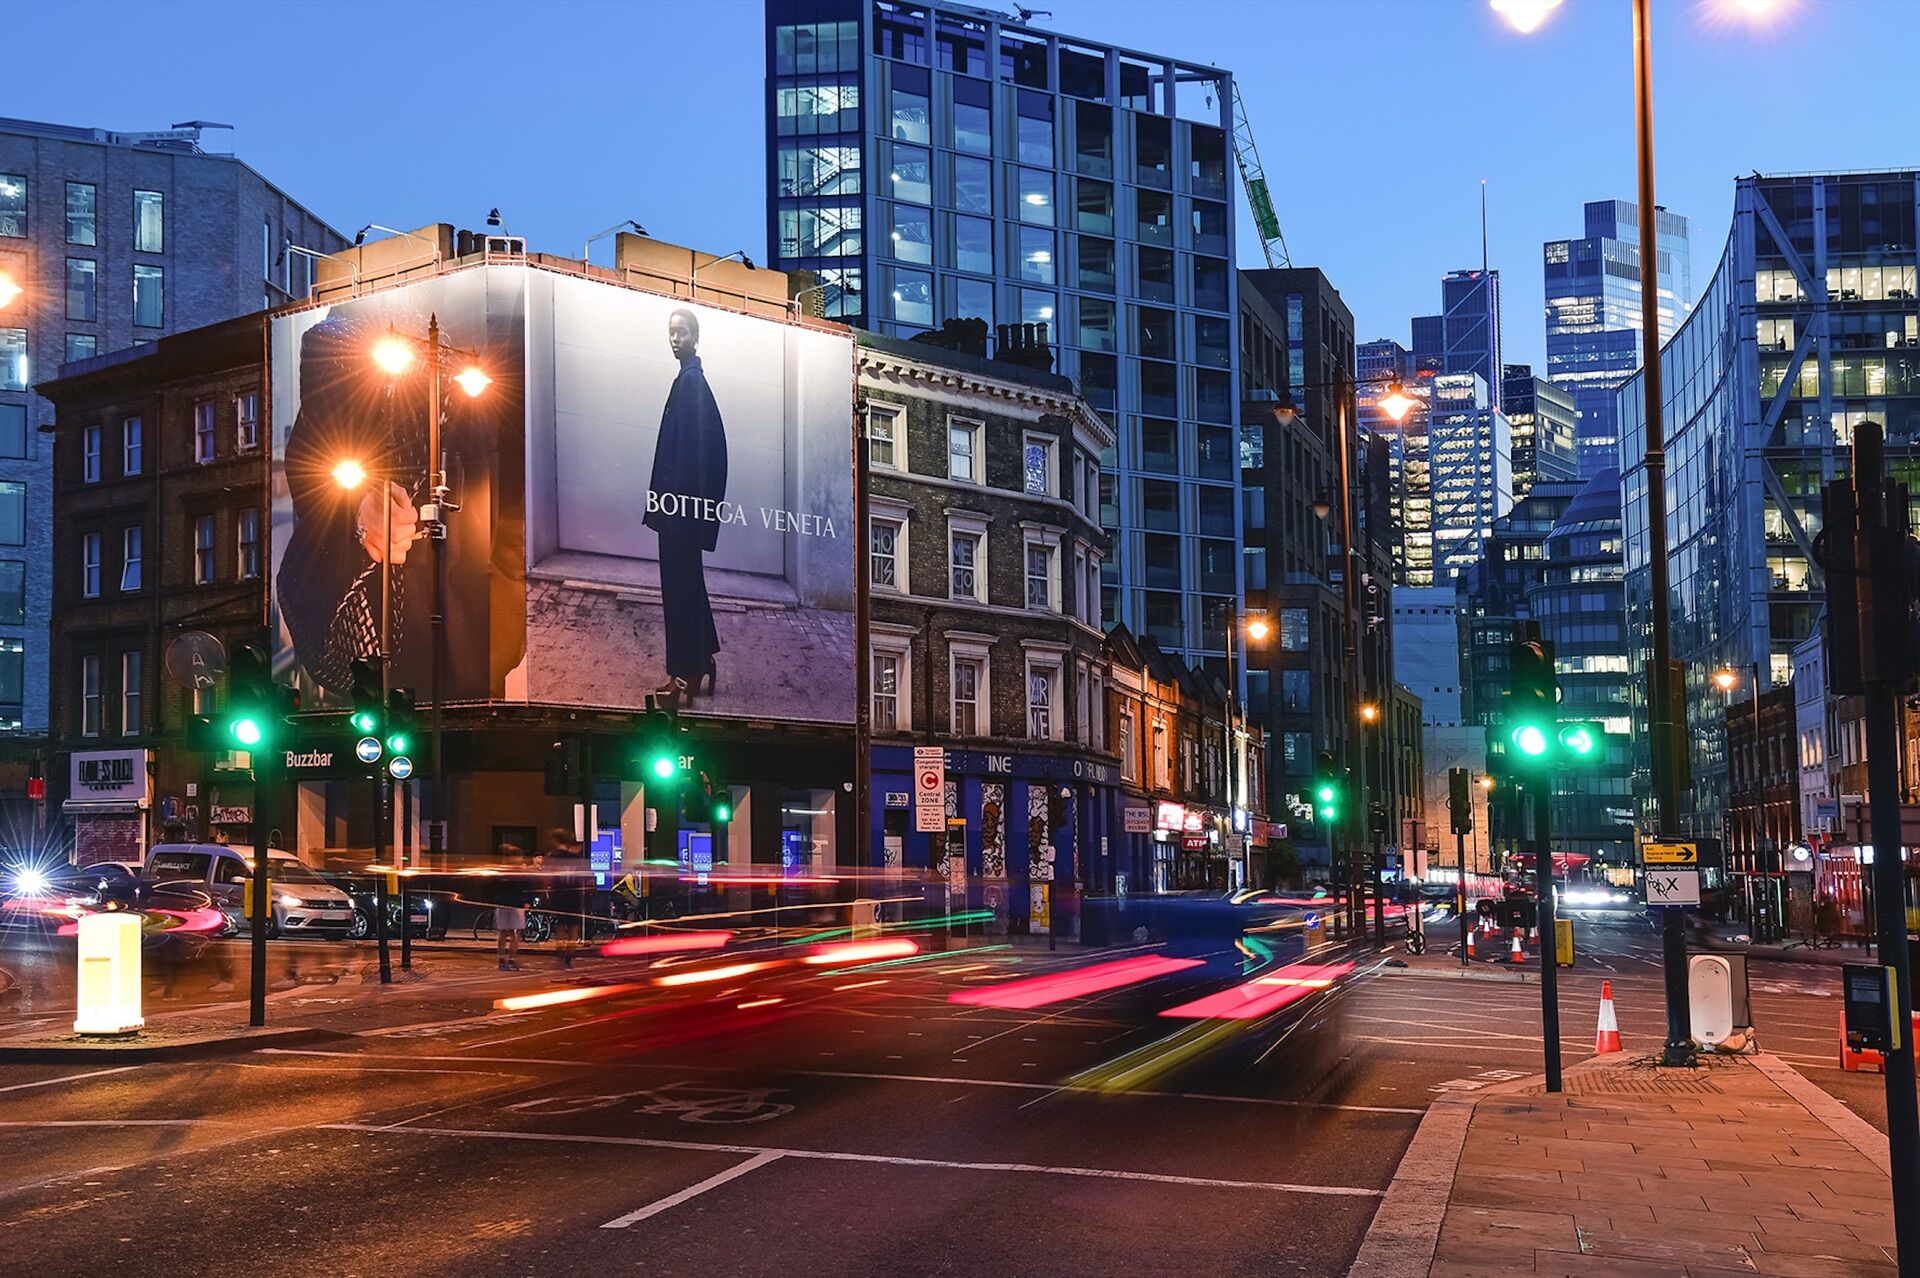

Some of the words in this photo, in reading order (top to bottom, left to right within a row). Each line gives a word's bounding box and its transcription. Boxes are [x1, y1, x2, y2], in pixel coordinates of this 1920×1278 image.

[646, 490, 748, 527] BOTTEGA
[760, 507, 837, 539] VENETA
[286, 749, 333, 768] Buzzbar
[1187, 839, 1207, 847] ATM
